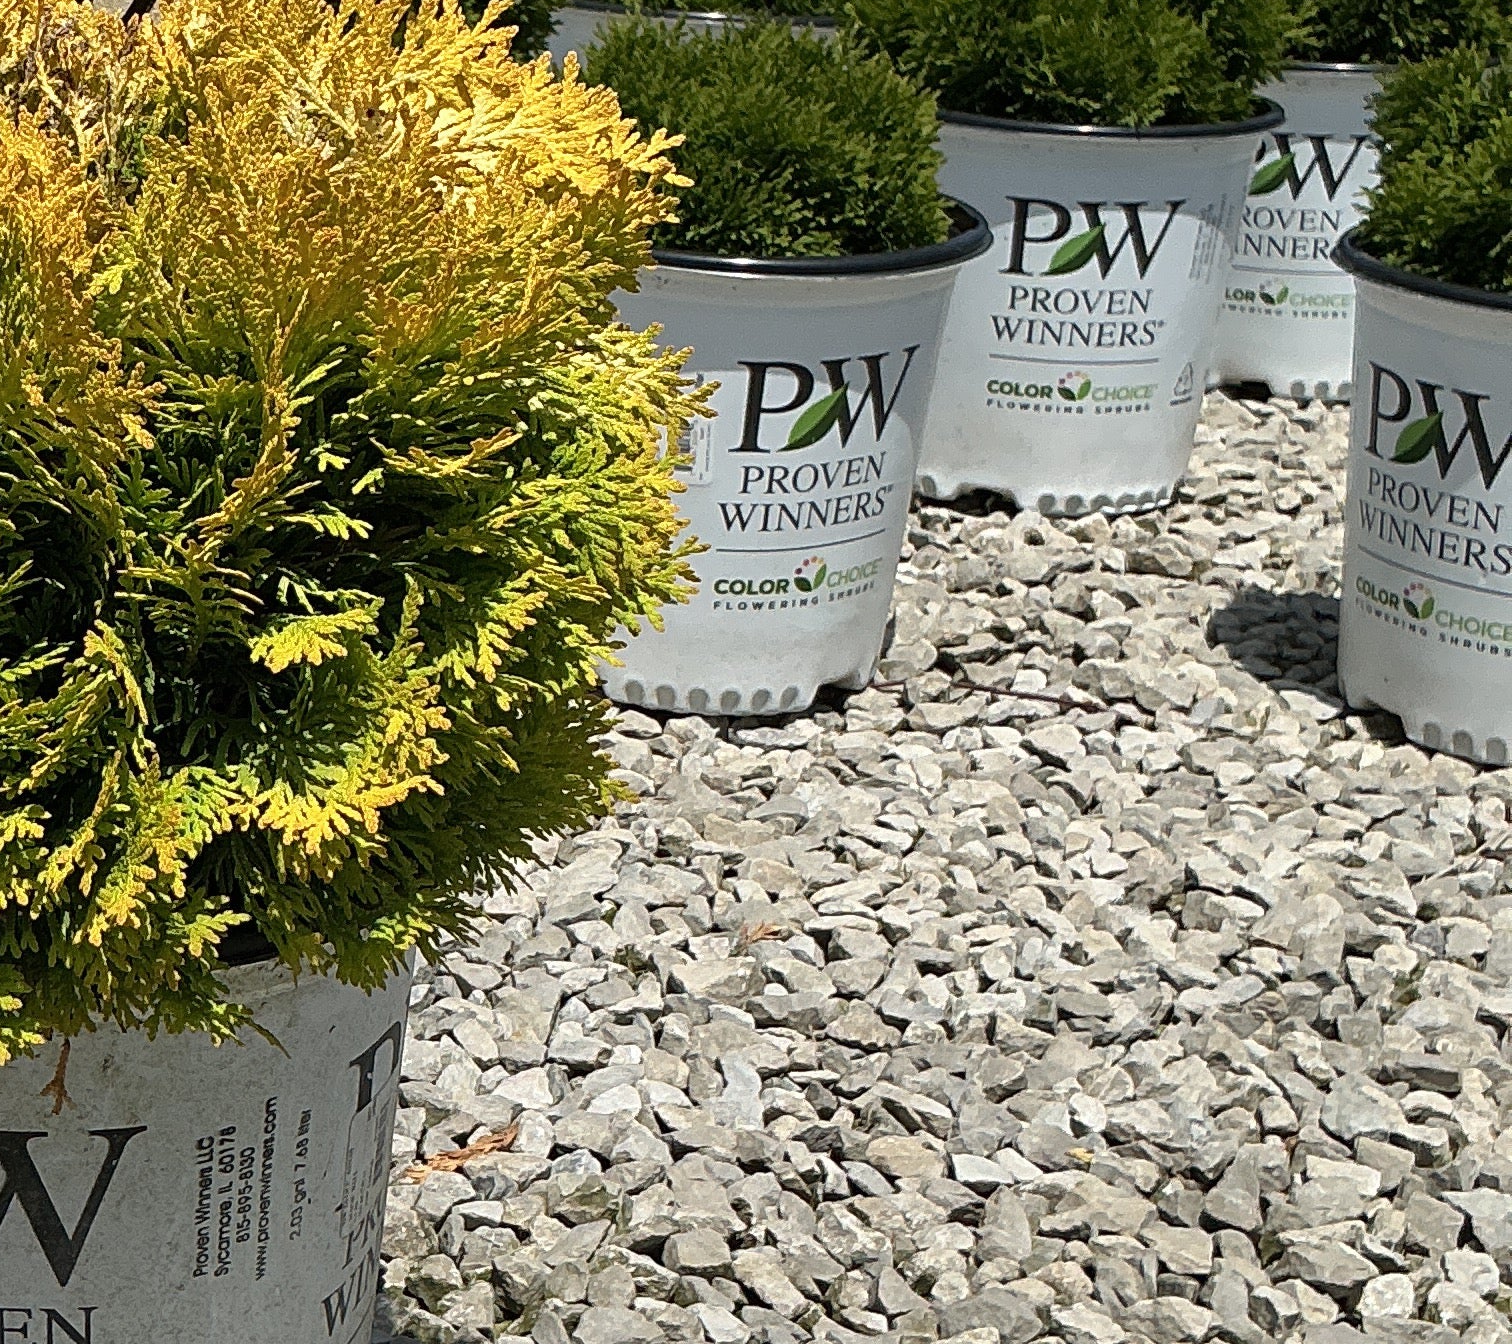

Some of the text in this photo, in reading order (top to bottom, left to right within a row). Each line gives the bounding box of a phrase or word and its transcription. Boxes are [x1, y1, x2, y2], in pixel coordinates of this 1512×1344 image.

[1255, 131, 1372, 202] W
[998, 195, 1186, 281] PW
[1241, 205, 1342, 233] ROVEN
[1241, 233, 1331, 261] NNER
[1008, 285, 1154, 316] PROVEN
[1225, 286, 1256, 303] LOR
[728, 344, 920, 453] PW
[987, 379, 1053, 399] COLOR
[1091, 384, 1155, 403] CHOICE
[1365, 360, 1512, 490] PW
[738, 451, 886, 494] PROVEN
[1368, 467, 1503, 534] PROVEN
[1359, 498, 1512, 576] WINNERS
[713, 559, 879, 596] COLOR CHOICE
[1356, 575, 1512, 642] COLOR CHOICE
[192, 1135, 215, 1278] Proven Winners LLC
[214, 1126, 237, 1278] Sycamore, IL 60178
[236, 1146, 255, 1243] 815-895-8130
[255, 1096, 278, 1281] www.provenwinners.com
